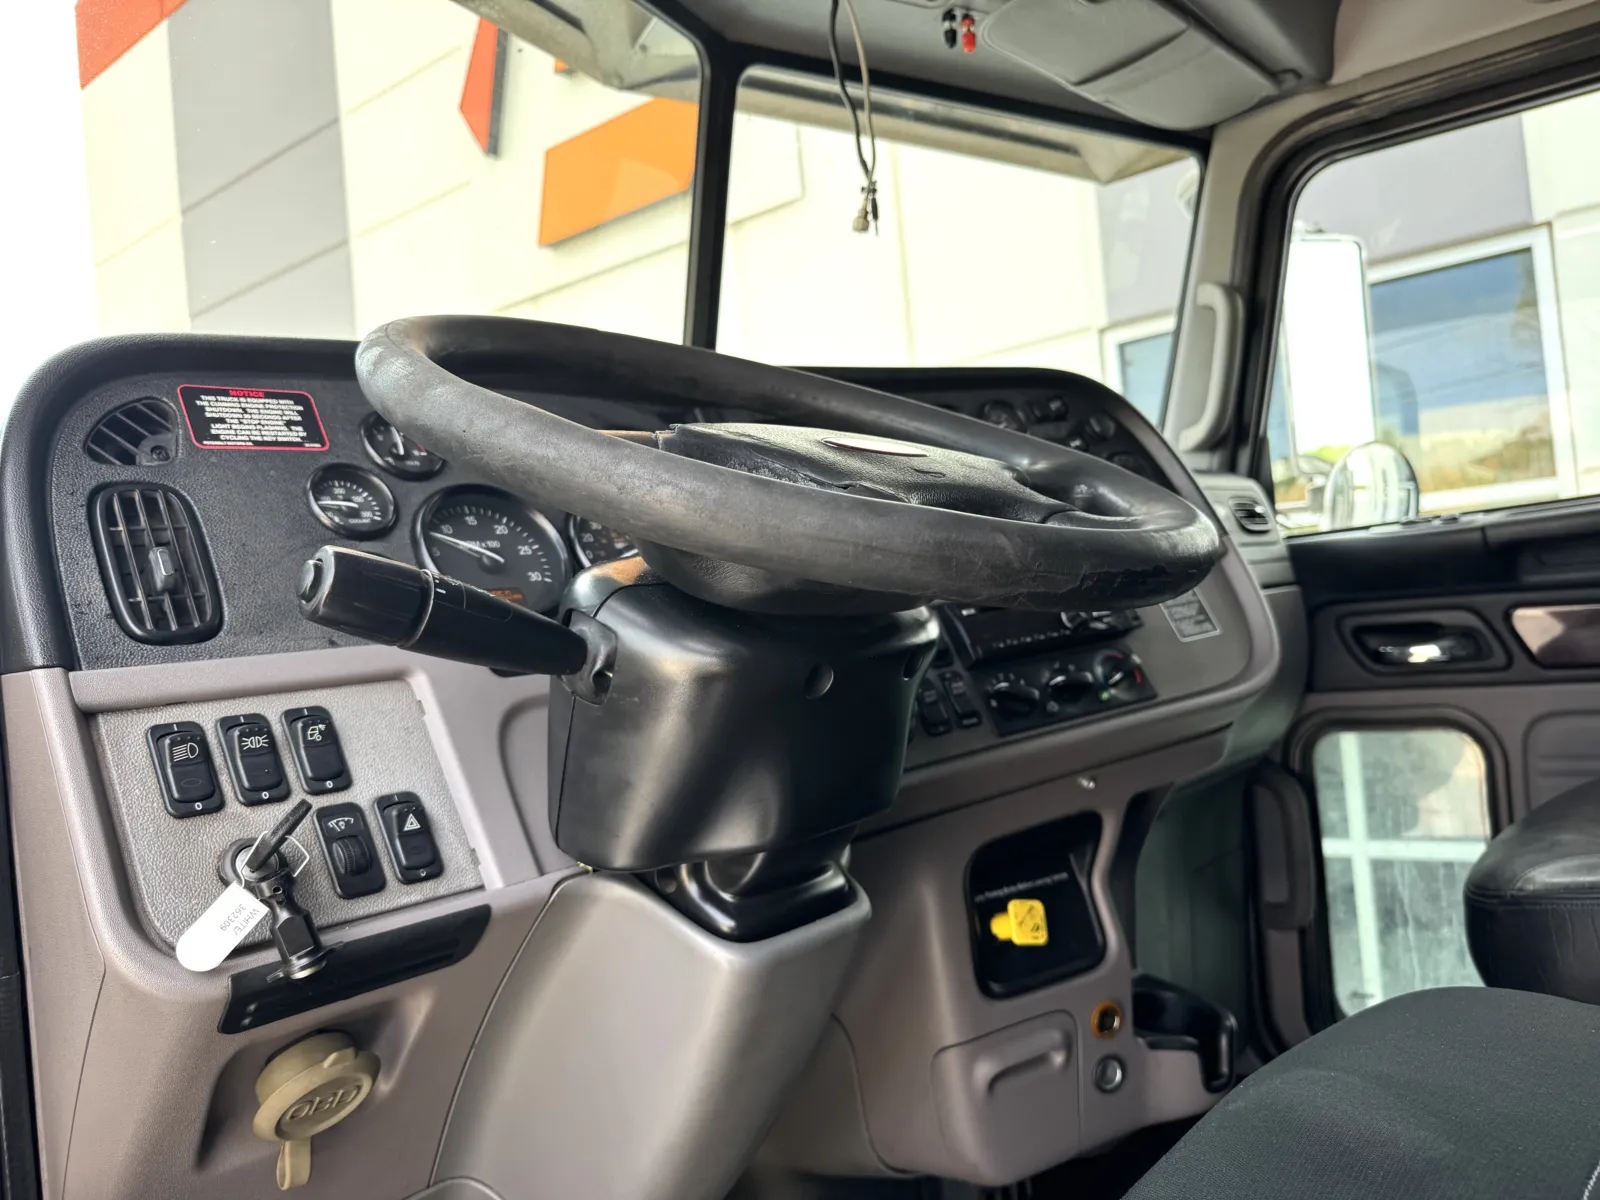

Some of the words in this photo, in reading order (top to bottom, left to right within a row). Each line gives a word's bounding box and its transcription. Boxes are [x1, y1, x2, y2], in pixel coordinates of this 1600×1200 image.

[229, 390, 265, 398] NOTICE
[464, 516, 478, 526] 15
[440, 525, 453, 535] 10
[493, 525, 508, 535] 20
[517, 545, 533, 555] 25
[527, 571, 542, 582] 30
[286, 1084, 361, 1121] OBD
